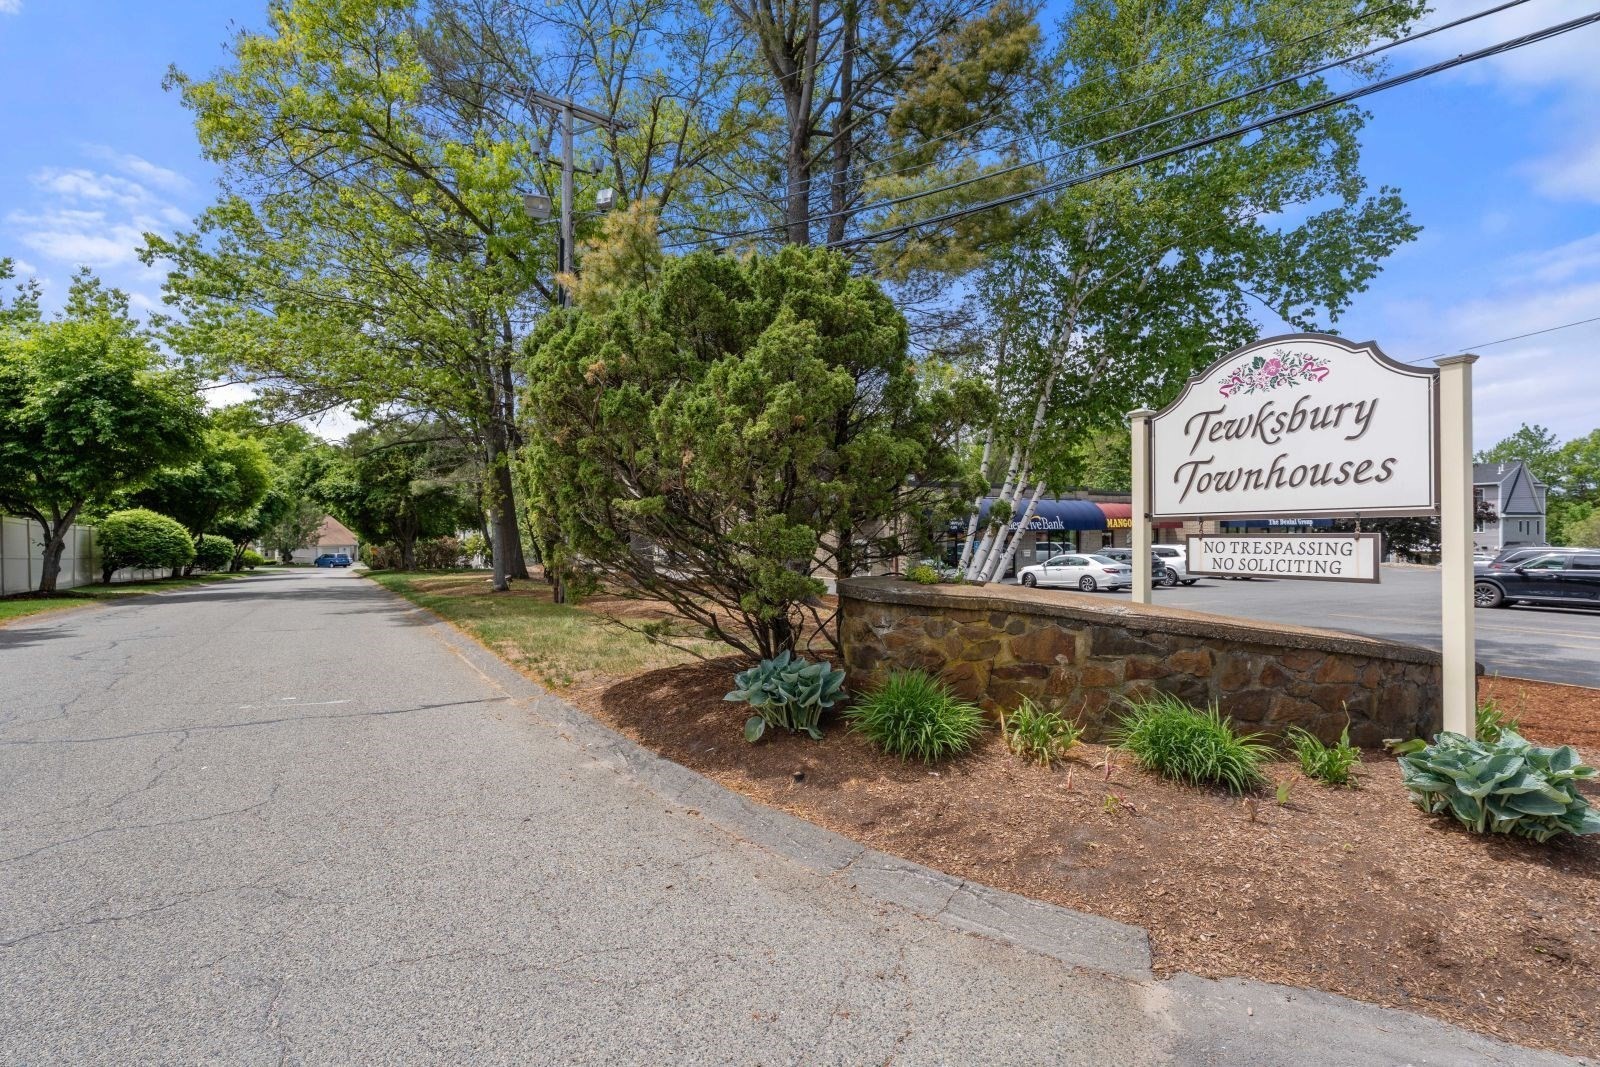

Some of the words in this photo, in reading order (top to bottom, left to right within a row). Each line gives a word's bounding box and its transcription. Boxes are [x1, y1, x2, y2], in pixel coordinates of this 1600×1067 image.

[1184, 394, 1380, 456] Tewksbury
[1173, 453, 1398, 504] Townhouses
[1203, 541, 1226, 554] NO
[1229, 541, 1354, 557] TRESPASSING
[1211, 557, 1235, 571] NO
[1238, 558, 1342, 575] SOLICITING
